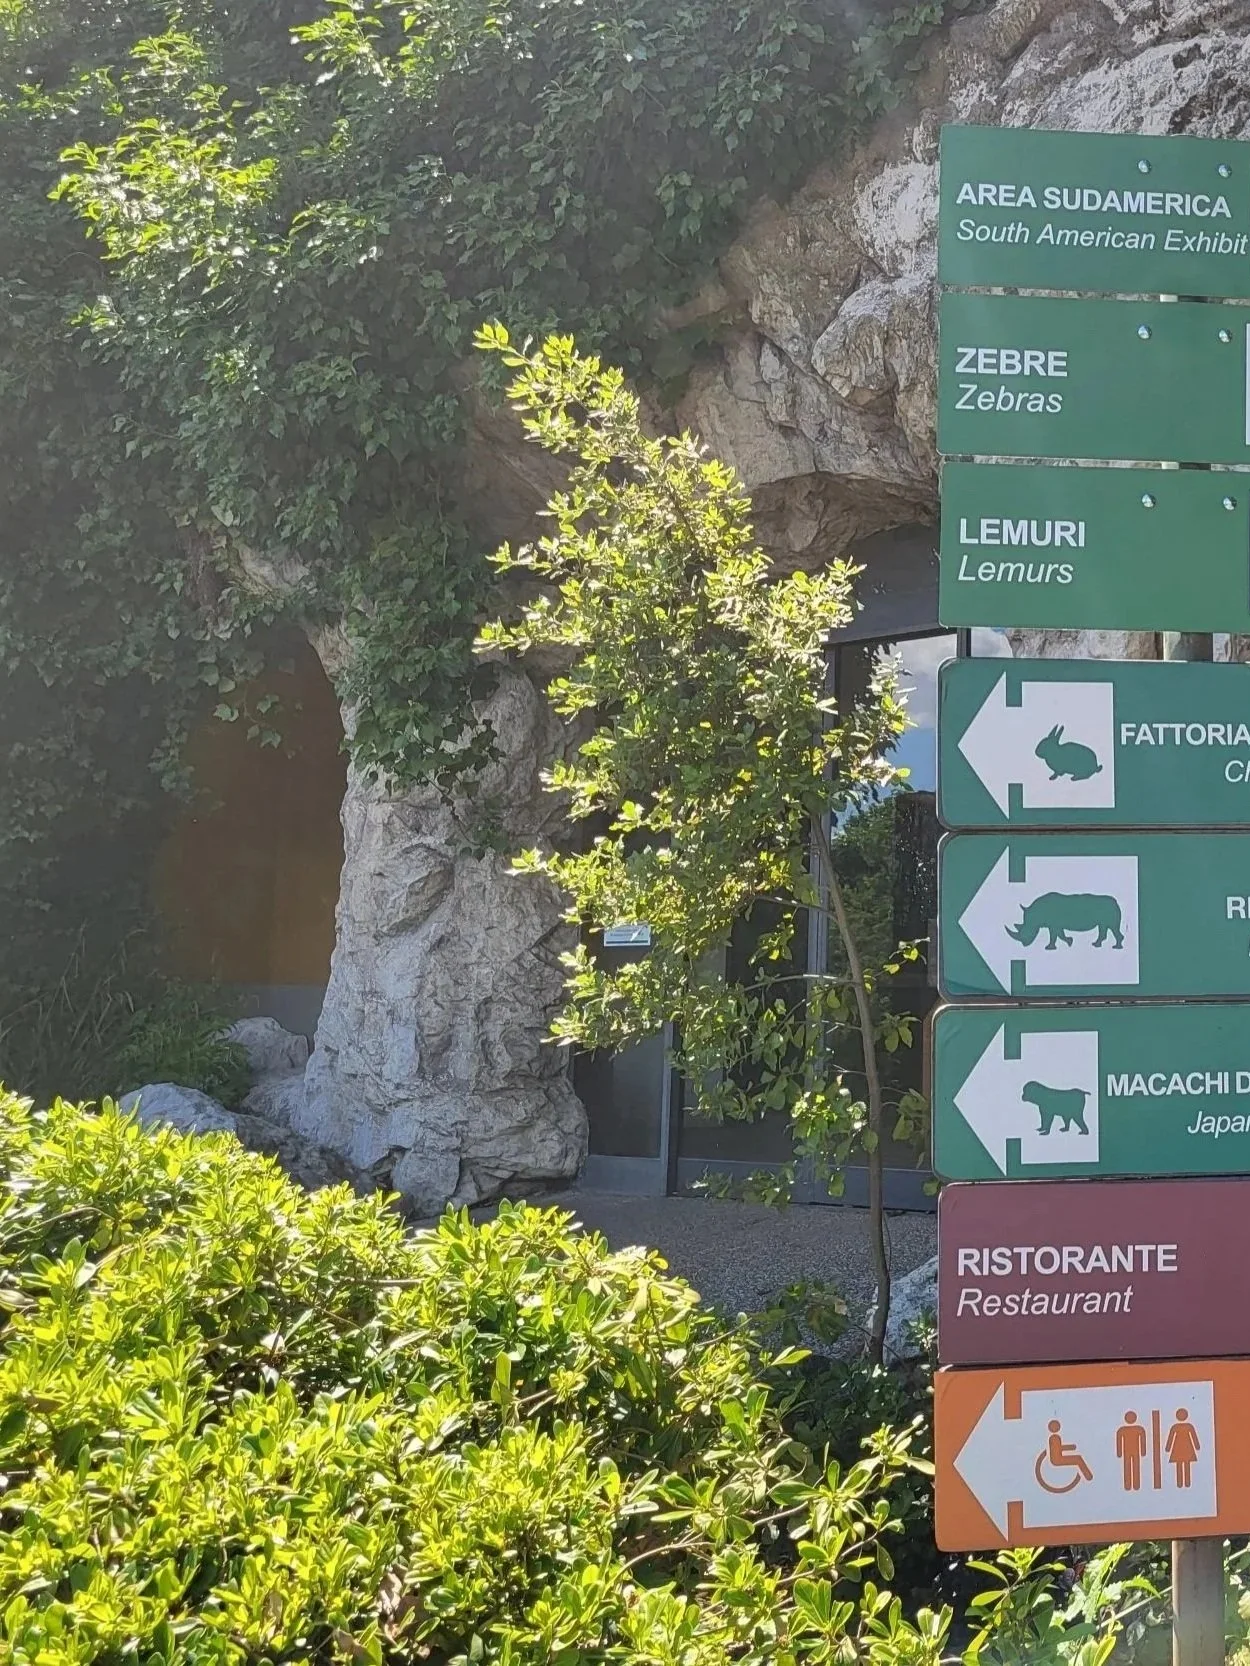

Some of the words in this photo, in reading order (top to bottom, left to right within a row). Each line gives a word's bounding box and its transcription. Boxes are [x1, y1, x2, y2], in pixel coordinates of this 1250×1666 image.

[956, 183, 1037, 208] AREA
[1043, 186, 1231, 218] SUDAMERICA
[956, 219, 1029, 244] South
[1036, 223, 1155, 250] American
[1164, 229, 1248, 255] Exhibit
[955, 347, 1068, 377] ZEBRE
[955, 384, 1063, 413] Zebras
[960, 519, 1085, 547] LEMURI
[958, 555, 1073, 584] Lemurs
[1107, 1071, 1229, 1097] MACACHI
[958, 1244, 1177, 1276] RISTORANTE
[957, 1285, 1133, 1317] Restaurant
